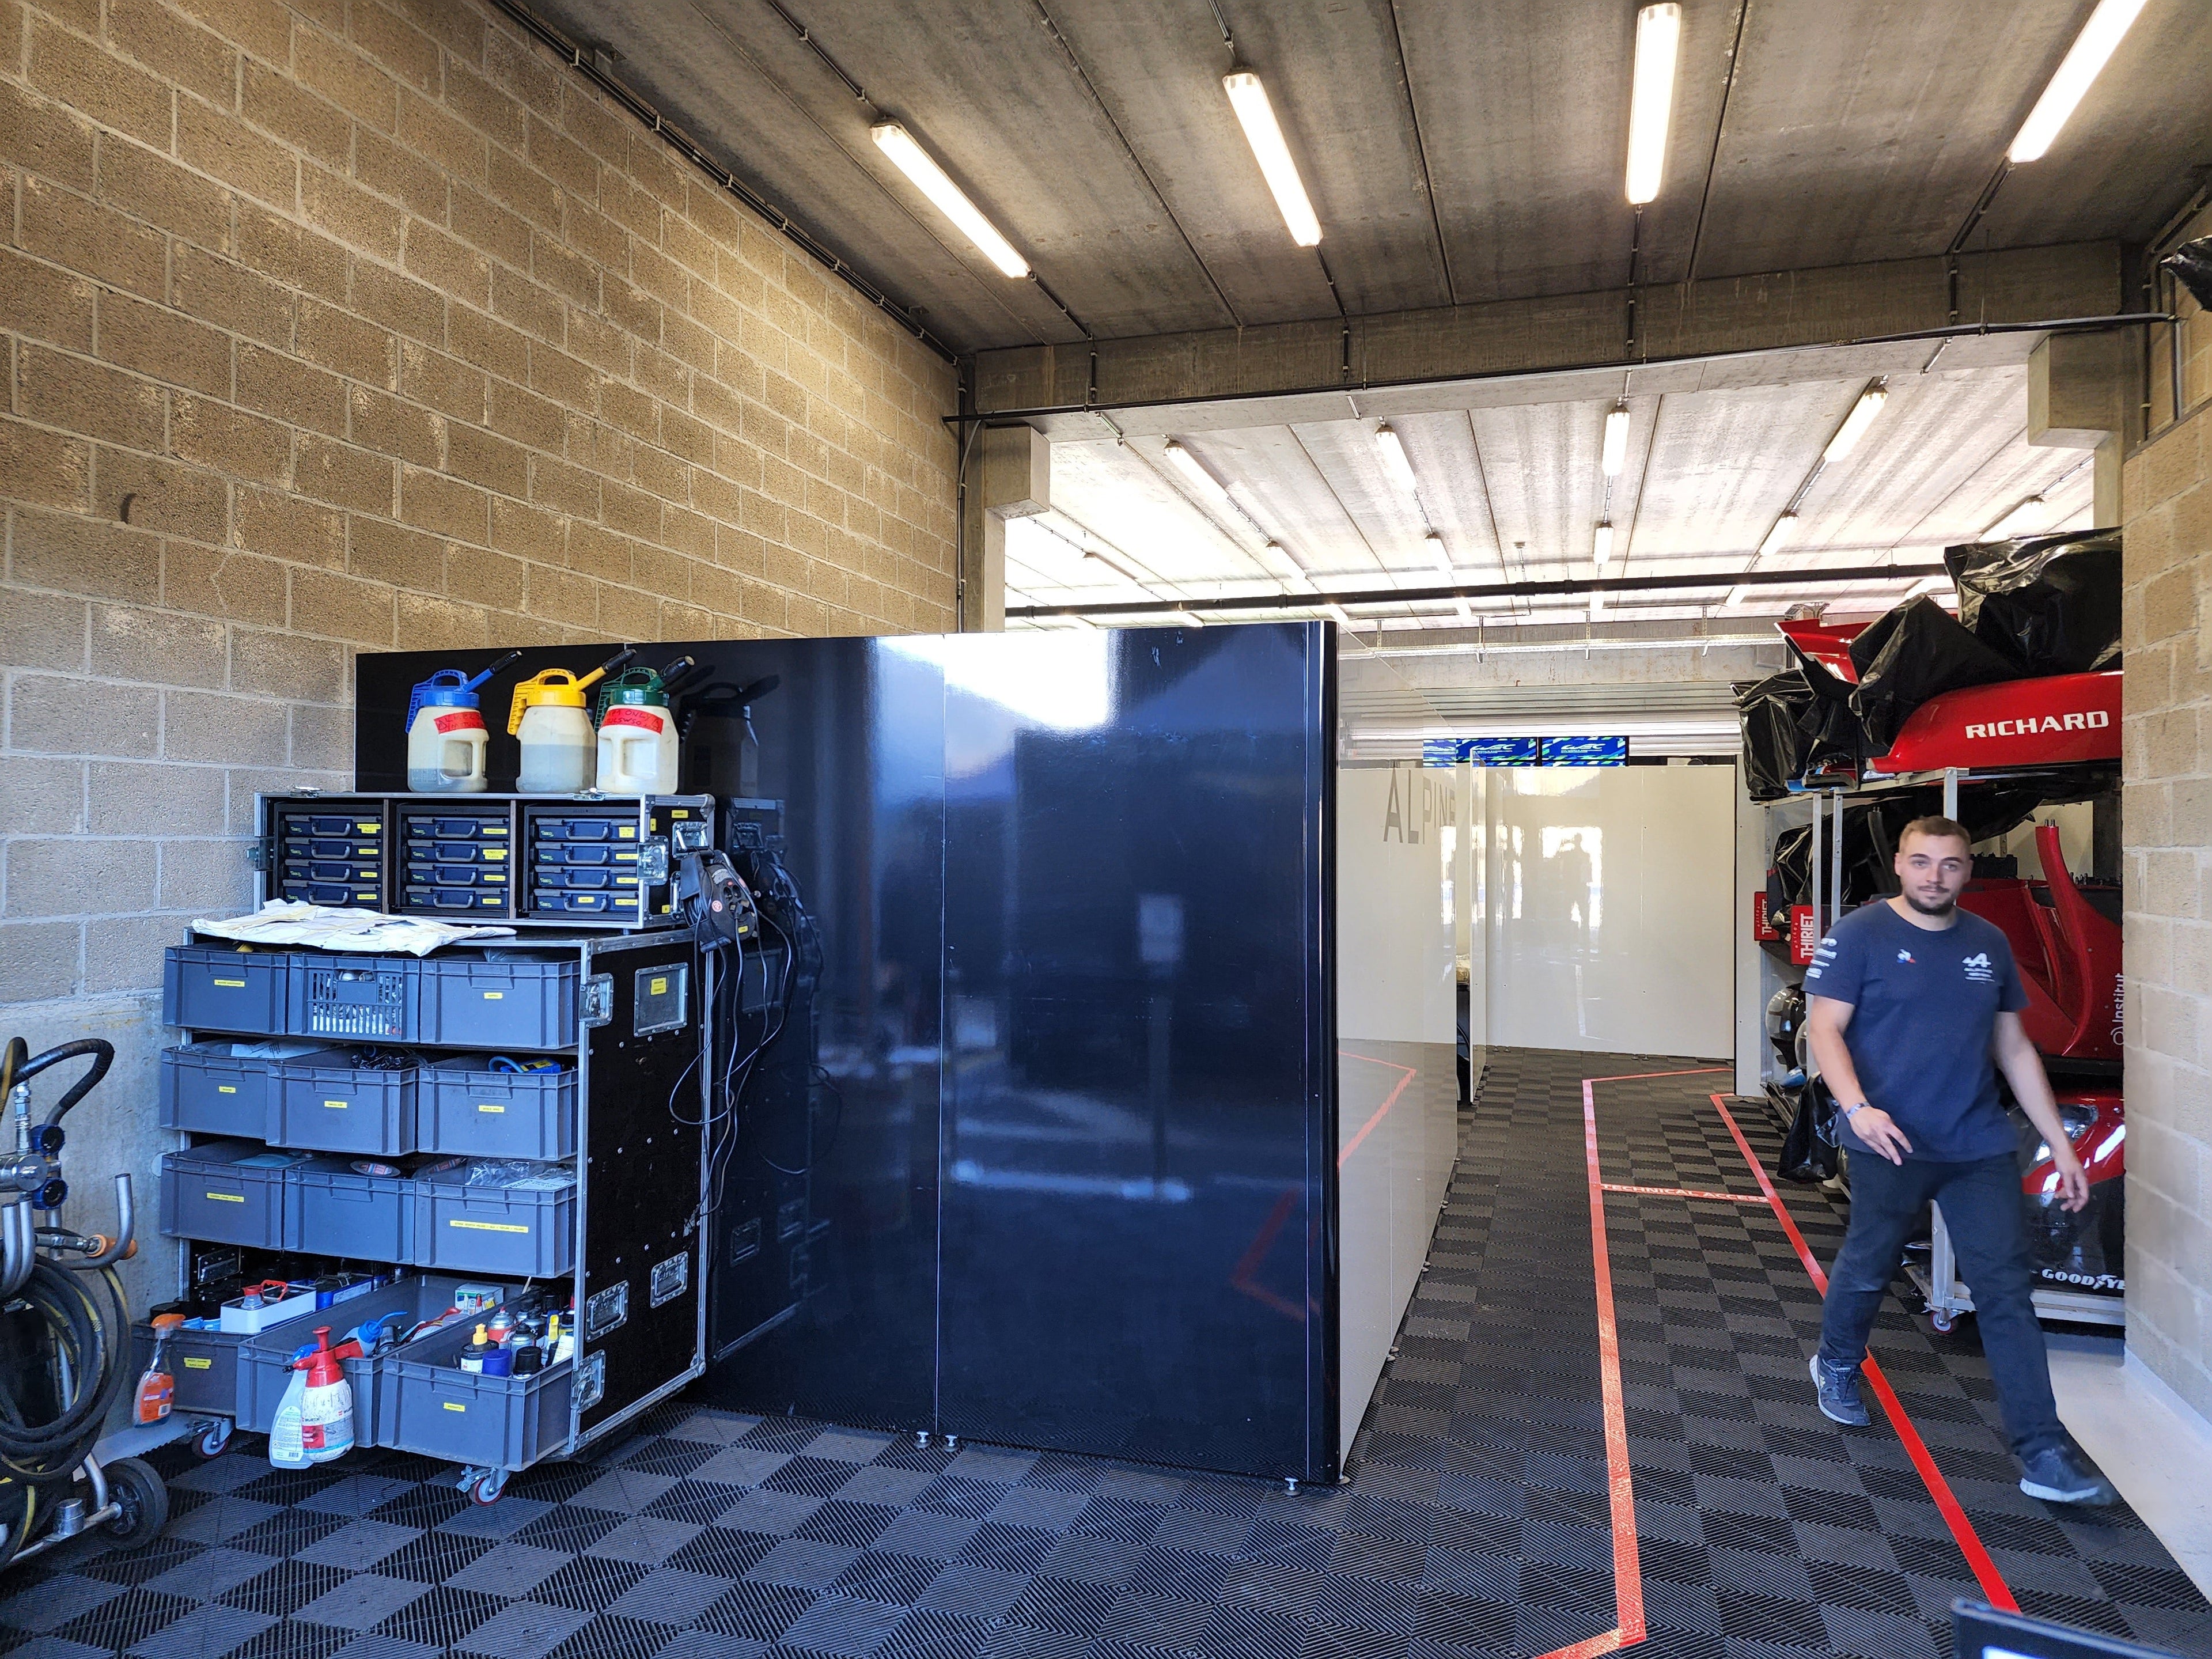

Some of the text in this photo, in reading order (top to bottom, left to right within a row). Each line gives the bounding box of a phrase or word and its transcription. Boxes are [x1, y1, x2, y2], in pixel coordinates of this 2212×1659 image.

[1965, 711, 2109, 738] RICHARD
[1383, 761, 1457, 844] ALPINE
[1801, 914, 1814, 959] THIRIET
[2112, 973, 2124, 1022] Institut
[1601, 1184, 1769, 1203] TECHNICAL ACCESS
